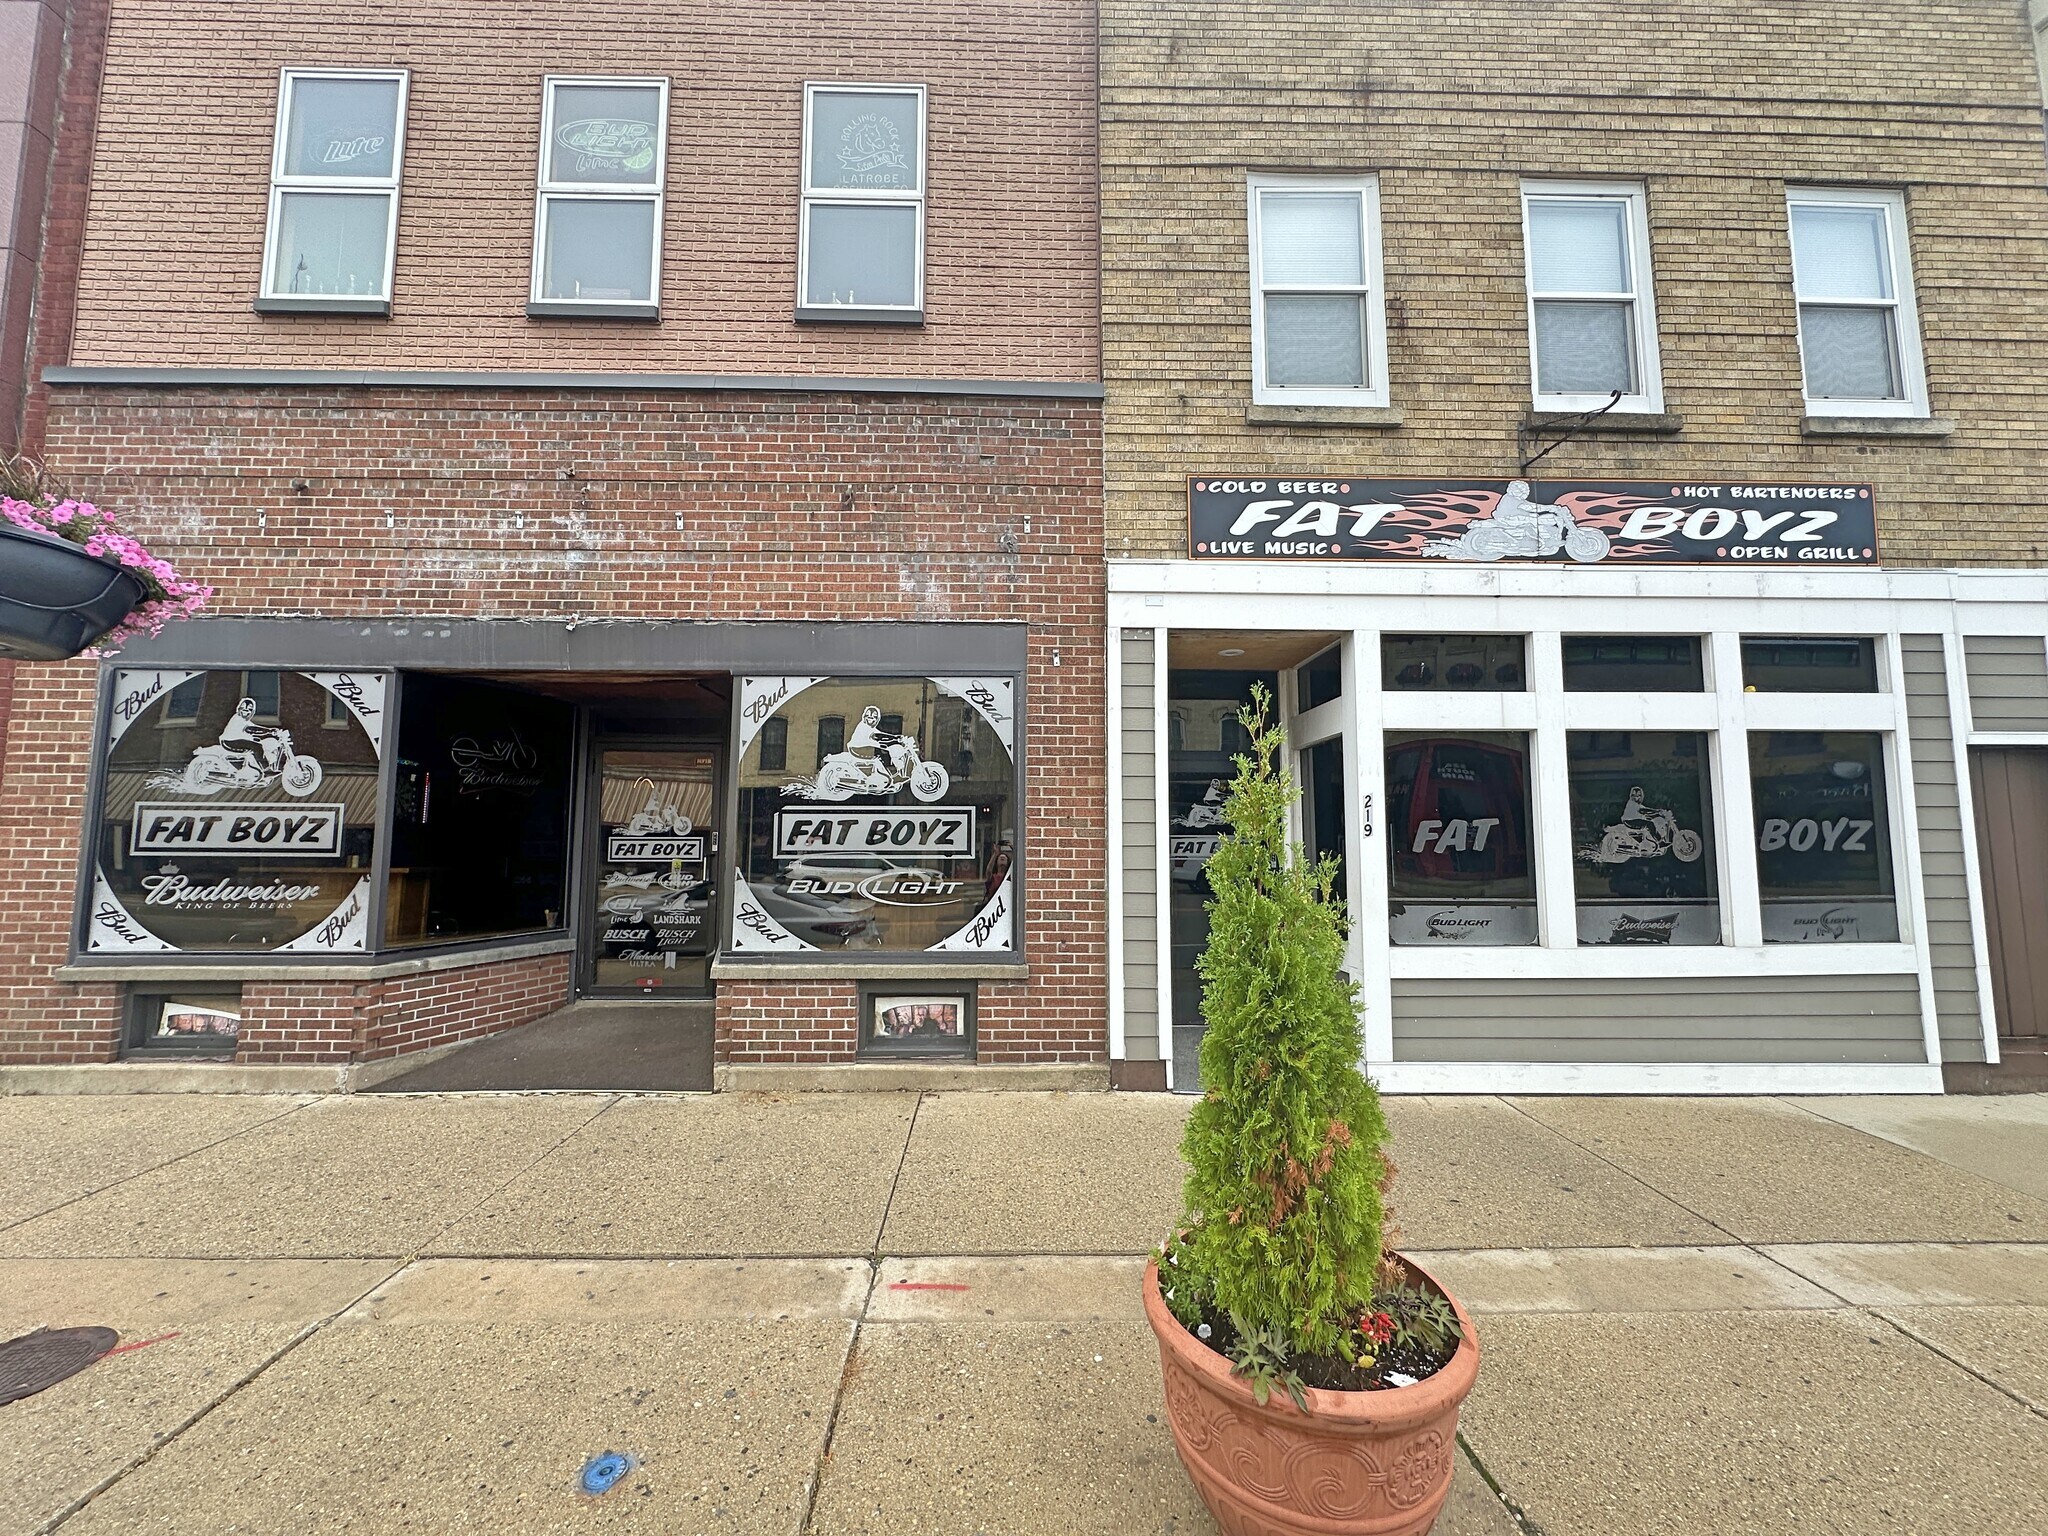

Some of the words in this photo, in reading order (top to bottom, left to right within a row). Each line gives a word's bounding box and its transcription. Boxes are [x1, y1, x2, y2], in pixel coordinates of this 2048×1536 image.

[586, 120, 648, 136] BUD
[841, 112, 877, 142] ROLLING
[880, 116, 900, 141] ROCK
[570, 133, 656, 149] LIGHT
[841, 173, 899, 184] LATROBE
[1208, 481, 1267, 494] COLD
[1277, 481, 1338, 494] BEER
[1683, 486, 1721, 498] HOT
[1730, 486, 1856, 499] BARTENDERS
[1229, 499, 1407, 538] FAT
[1619, 507, 1838, 541] BOYZ
[1209, 541, 1255, 555] LIVE
[1264, 541, 1328, 555] MUSIC
[1730, 546, 1788, 559] OPEN
[1797, 547, 1859, 560] GRILL
[114, 672, 163, 720] Bud
[332, 673, 380, 717] Bud
[743, 677, 789, 724] Bud
[965, 679, 1012, 724] Bud
[1364, 794, 1373, 837] 219
[145, 815, 222, 843] FAT
[226, 814, 331, 843] BOYZ
[786, 819, 859, 847] FAT
[865, 818, 962, 846] BOYZ
[1412, 818, 1500, 853] FAT
[1760, 817, 1873, 851] BOYZ
[614, 843, 649, 856] FAT
[651, 842, 698, 857] BOYZ
[1174, 842, 1206, 854] FAT
[141, 874, 320, 906] Budweiser
[787, 880, 860, 894] BUD
[871, 880, 964, 895] LIGHT
[174, 902, 214, 910] KING
[222, 902, 241, 910] OF
[248, 902, 294, 910] BEERS
[95, 901, 148, 944] Bud
[316, 893, 361, 947] Bud
[610, 914, 628, 924] Lime
[653, 914, 701, 925] LANDSHARK
[736, 902, 788, 944] Bud
[966, 895, 1007, 948] Bud
[1430, 918, 1456, 926] BUD
[1457, 918, 1493, 928] LIGHT
[1609, 917, 1680, 931] Budweiser
[1825, 917, 1857, 925] LIGHT
[603, 929, 650, 940] BUSCH
[656, 929, 697, 939] BUSCH
[657, 938, 689, 947] LIGHT
[618, 949, 664, 961] Michelob
[629, 960, 656, 968] ULTRA
